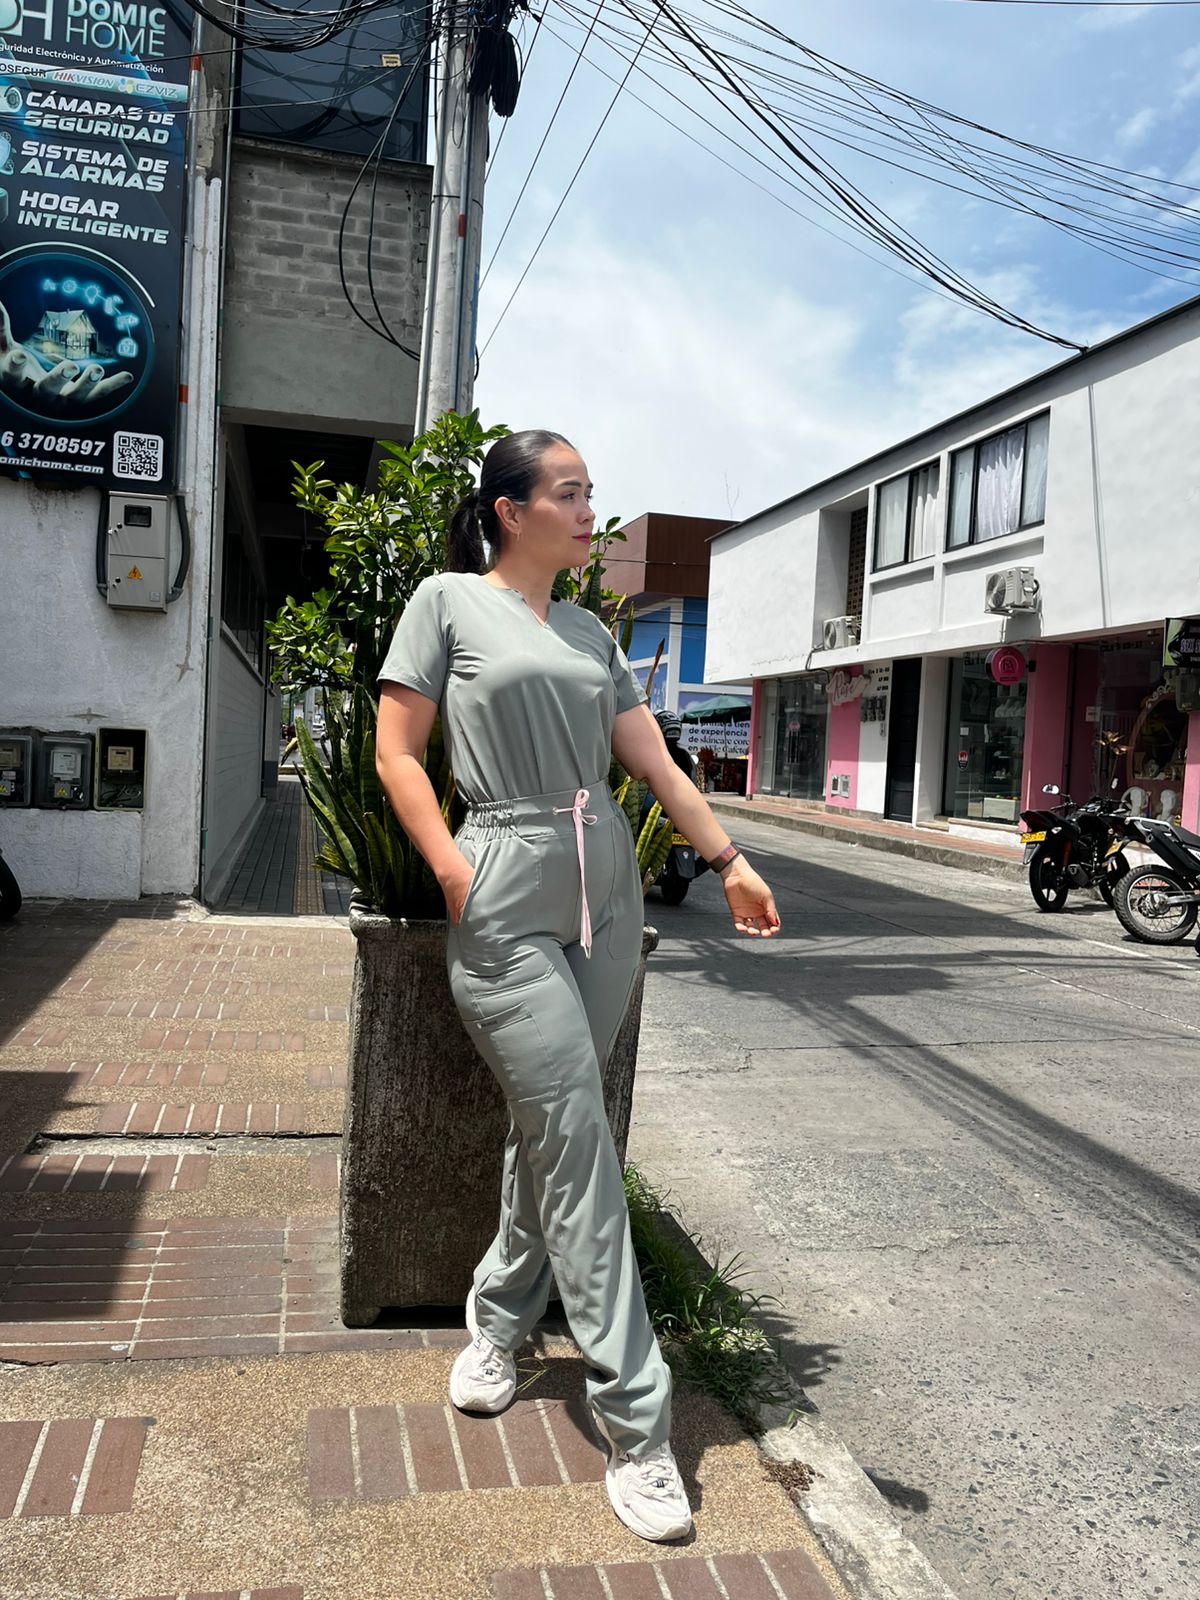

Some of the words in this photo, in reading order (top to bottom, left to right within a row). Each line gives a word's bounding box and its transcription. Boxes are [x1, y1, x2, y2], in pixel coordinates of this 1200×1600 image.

[66, 0, 167, 30] DOMIC
[66, 16, 165, 57] HOME
[36, 47, 86, 62] Electrónica
[54, 71, 114, 89] HIKVISION
[136, 83, 177, 97] EZVIZ
[26, 90, 144, 121] CÁMARAS
[148, 111, 175, 126] DE
[23, 110, 170, 145] SEGURIDAD
[21, 140, 127, 169] SISTEMA
[137, 156, 169, 175] DE
[20, 157, 165, 192] ALARMAS
[19, 189, 120, 219] HOGAR
[17, 210, 169, 245] INTELIGENTE
[18, 433, 106, 456] 3708597
[688, 735, 699, 743] de
[700, 736, 732, 745] skincae
[701, 728, 748, 737] experencia
